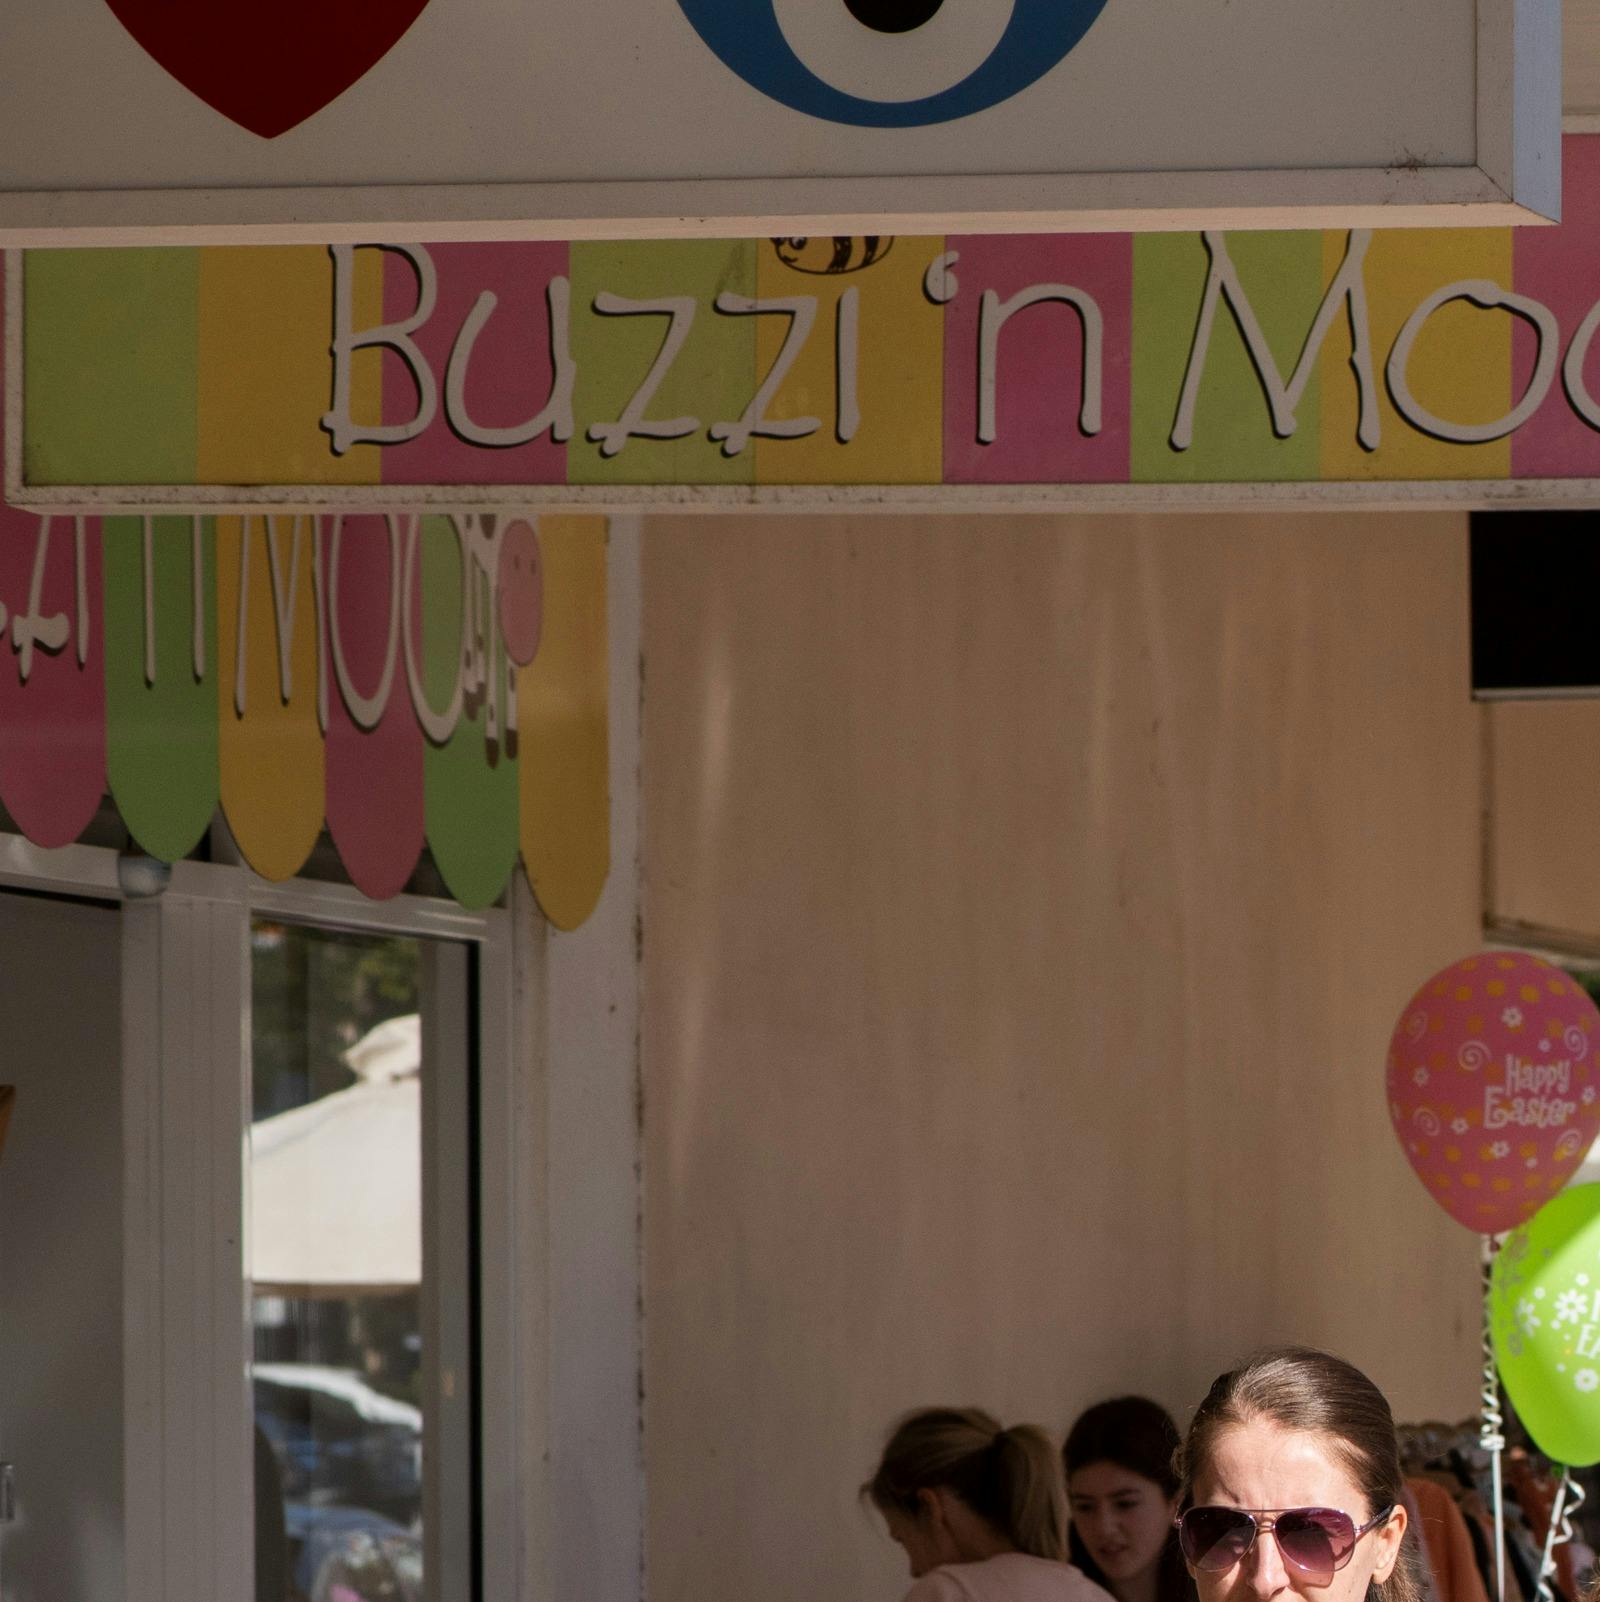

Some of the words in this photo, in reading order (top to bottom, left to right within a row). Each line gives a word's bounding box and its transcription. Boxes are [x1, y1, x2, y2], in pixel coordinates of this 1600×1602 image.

[319, 242, 860, 456] Buzzi
[1504, 1053, 1572, 1096] Happy
[1484, 1084, 1576, 1129] Easter
